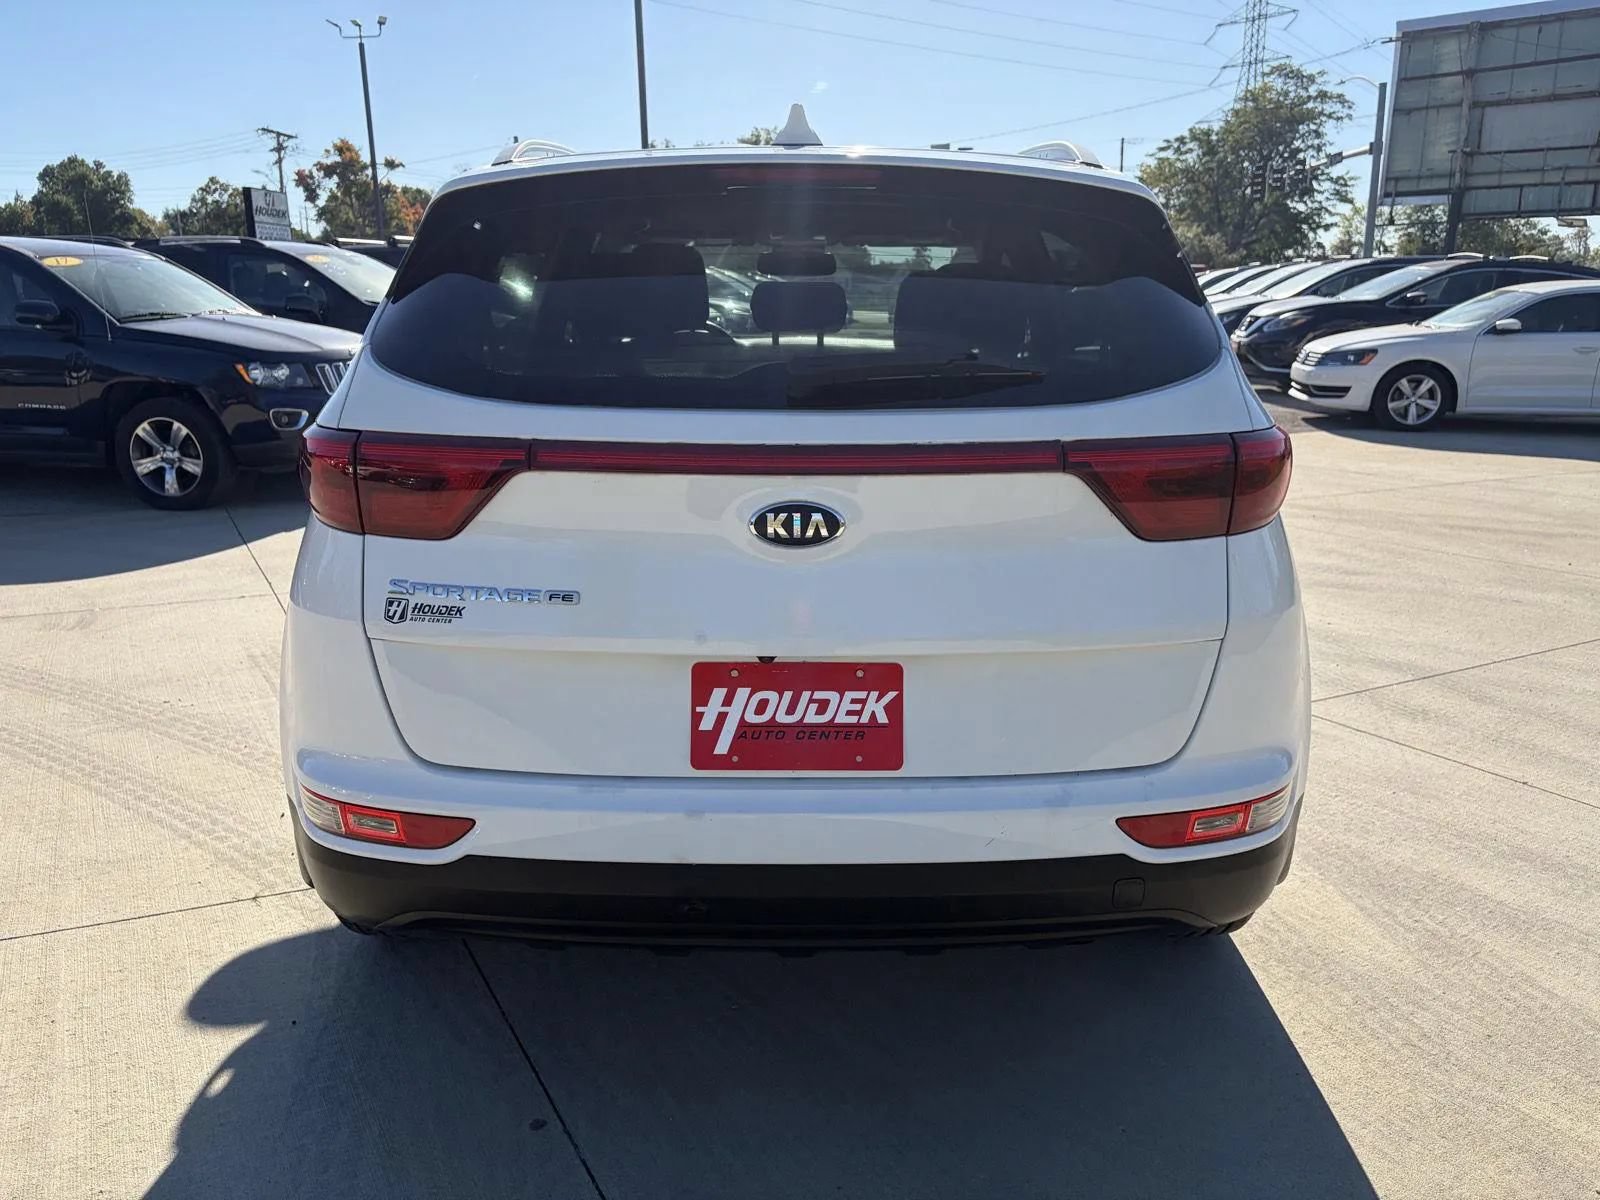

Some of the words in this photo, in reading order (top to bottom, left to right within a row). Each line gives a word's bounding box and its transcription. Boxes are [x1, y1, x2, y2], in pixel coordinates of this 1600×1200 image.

[765, 512, 830, 539] KIA
[387, 578, 543, 604] SPORTAGE
[548, 592, 575, 603] FE
[411, 602, 466, 617] HOUDEK
[427, 616, 453, 624] CENTER
[695, 687, 900, 755] HOUDEK
[736, 730, 786, 740] AUTO
[795, 730, 867, 741] CENTER
